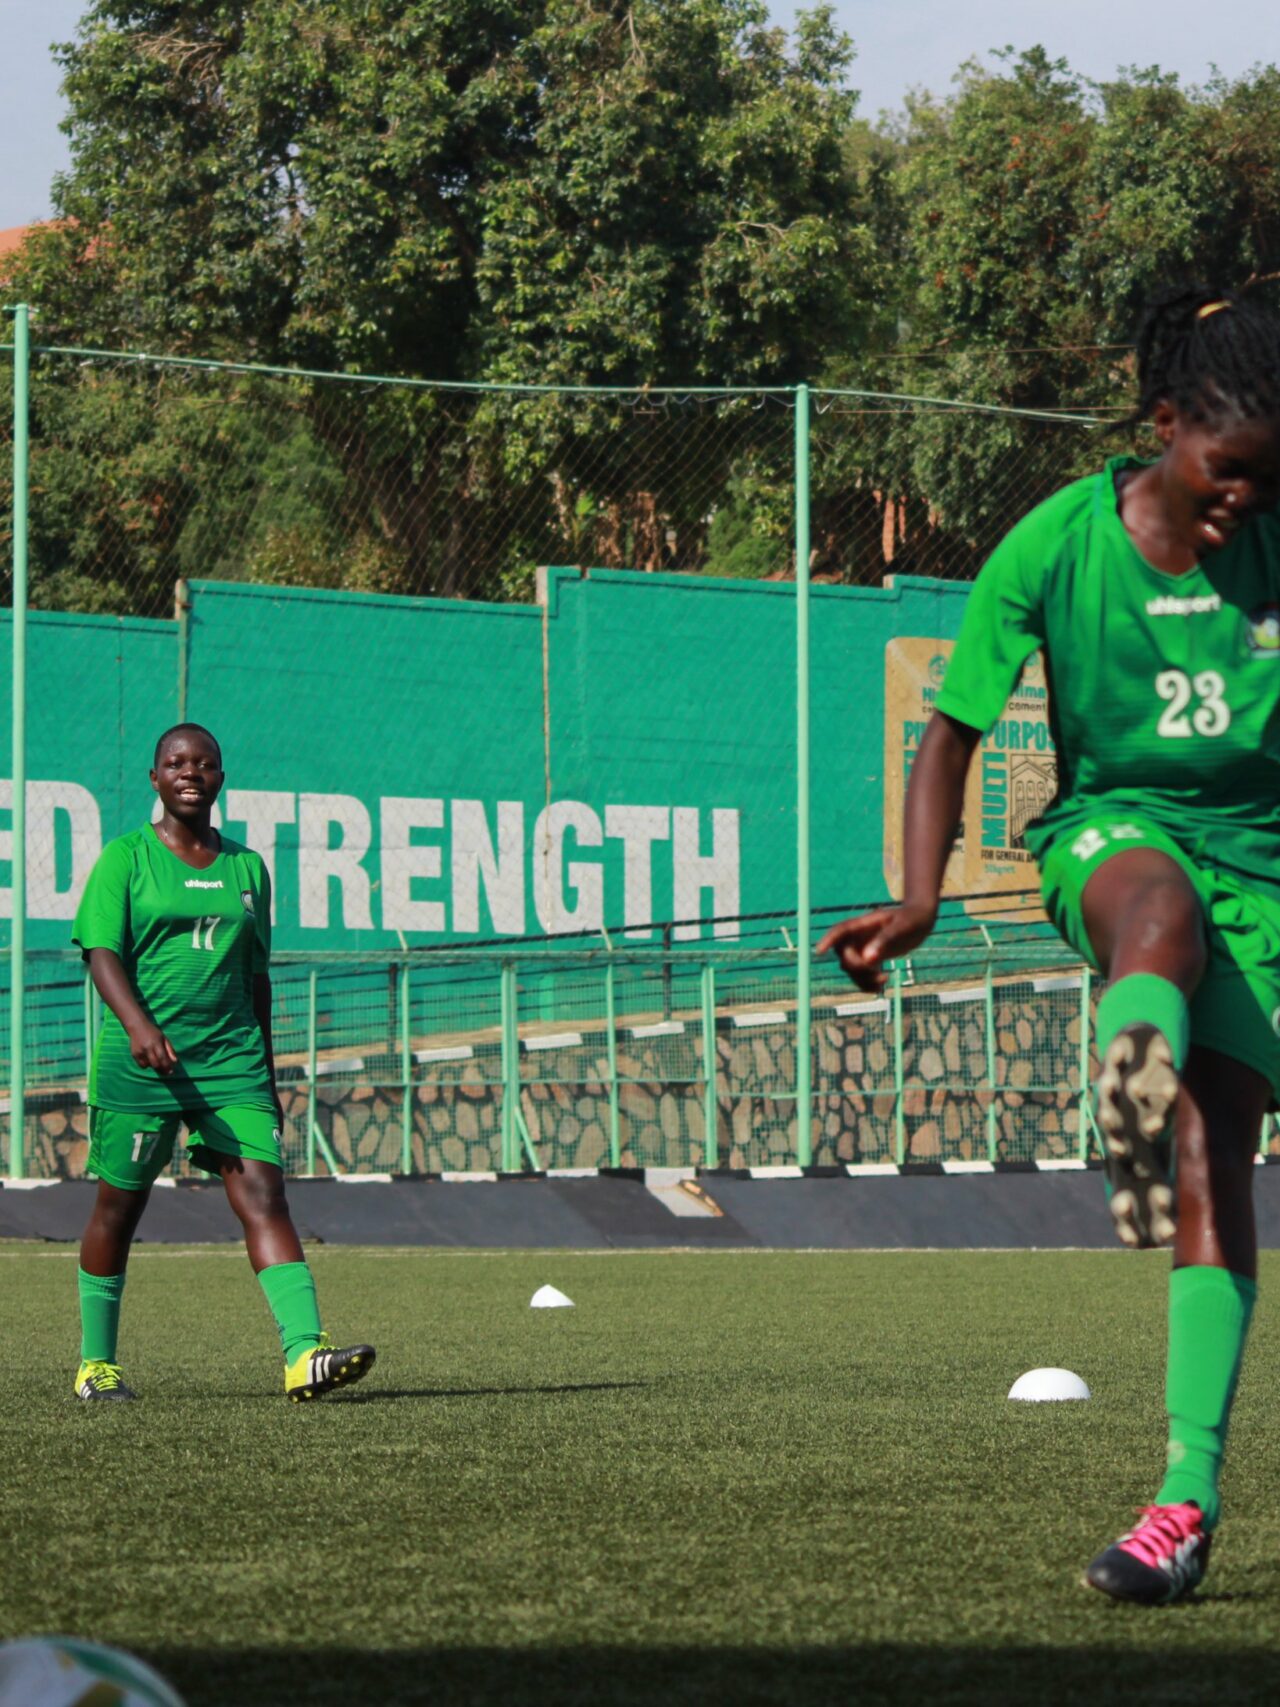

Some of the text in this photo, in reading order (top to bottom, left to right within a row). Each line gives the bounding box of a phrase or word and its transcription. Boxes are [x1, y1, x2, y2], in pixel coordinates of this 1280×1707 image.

[1008, 702, 1046, 713] cement
[1155, 669, 1231, 738] 23
[982, 752, 1008, 848] MULTI
[151, 785, 740, 942] TRENGTH
[184, 879, 224, 889] uhlsport
[191, 916, 221, 951] 17
